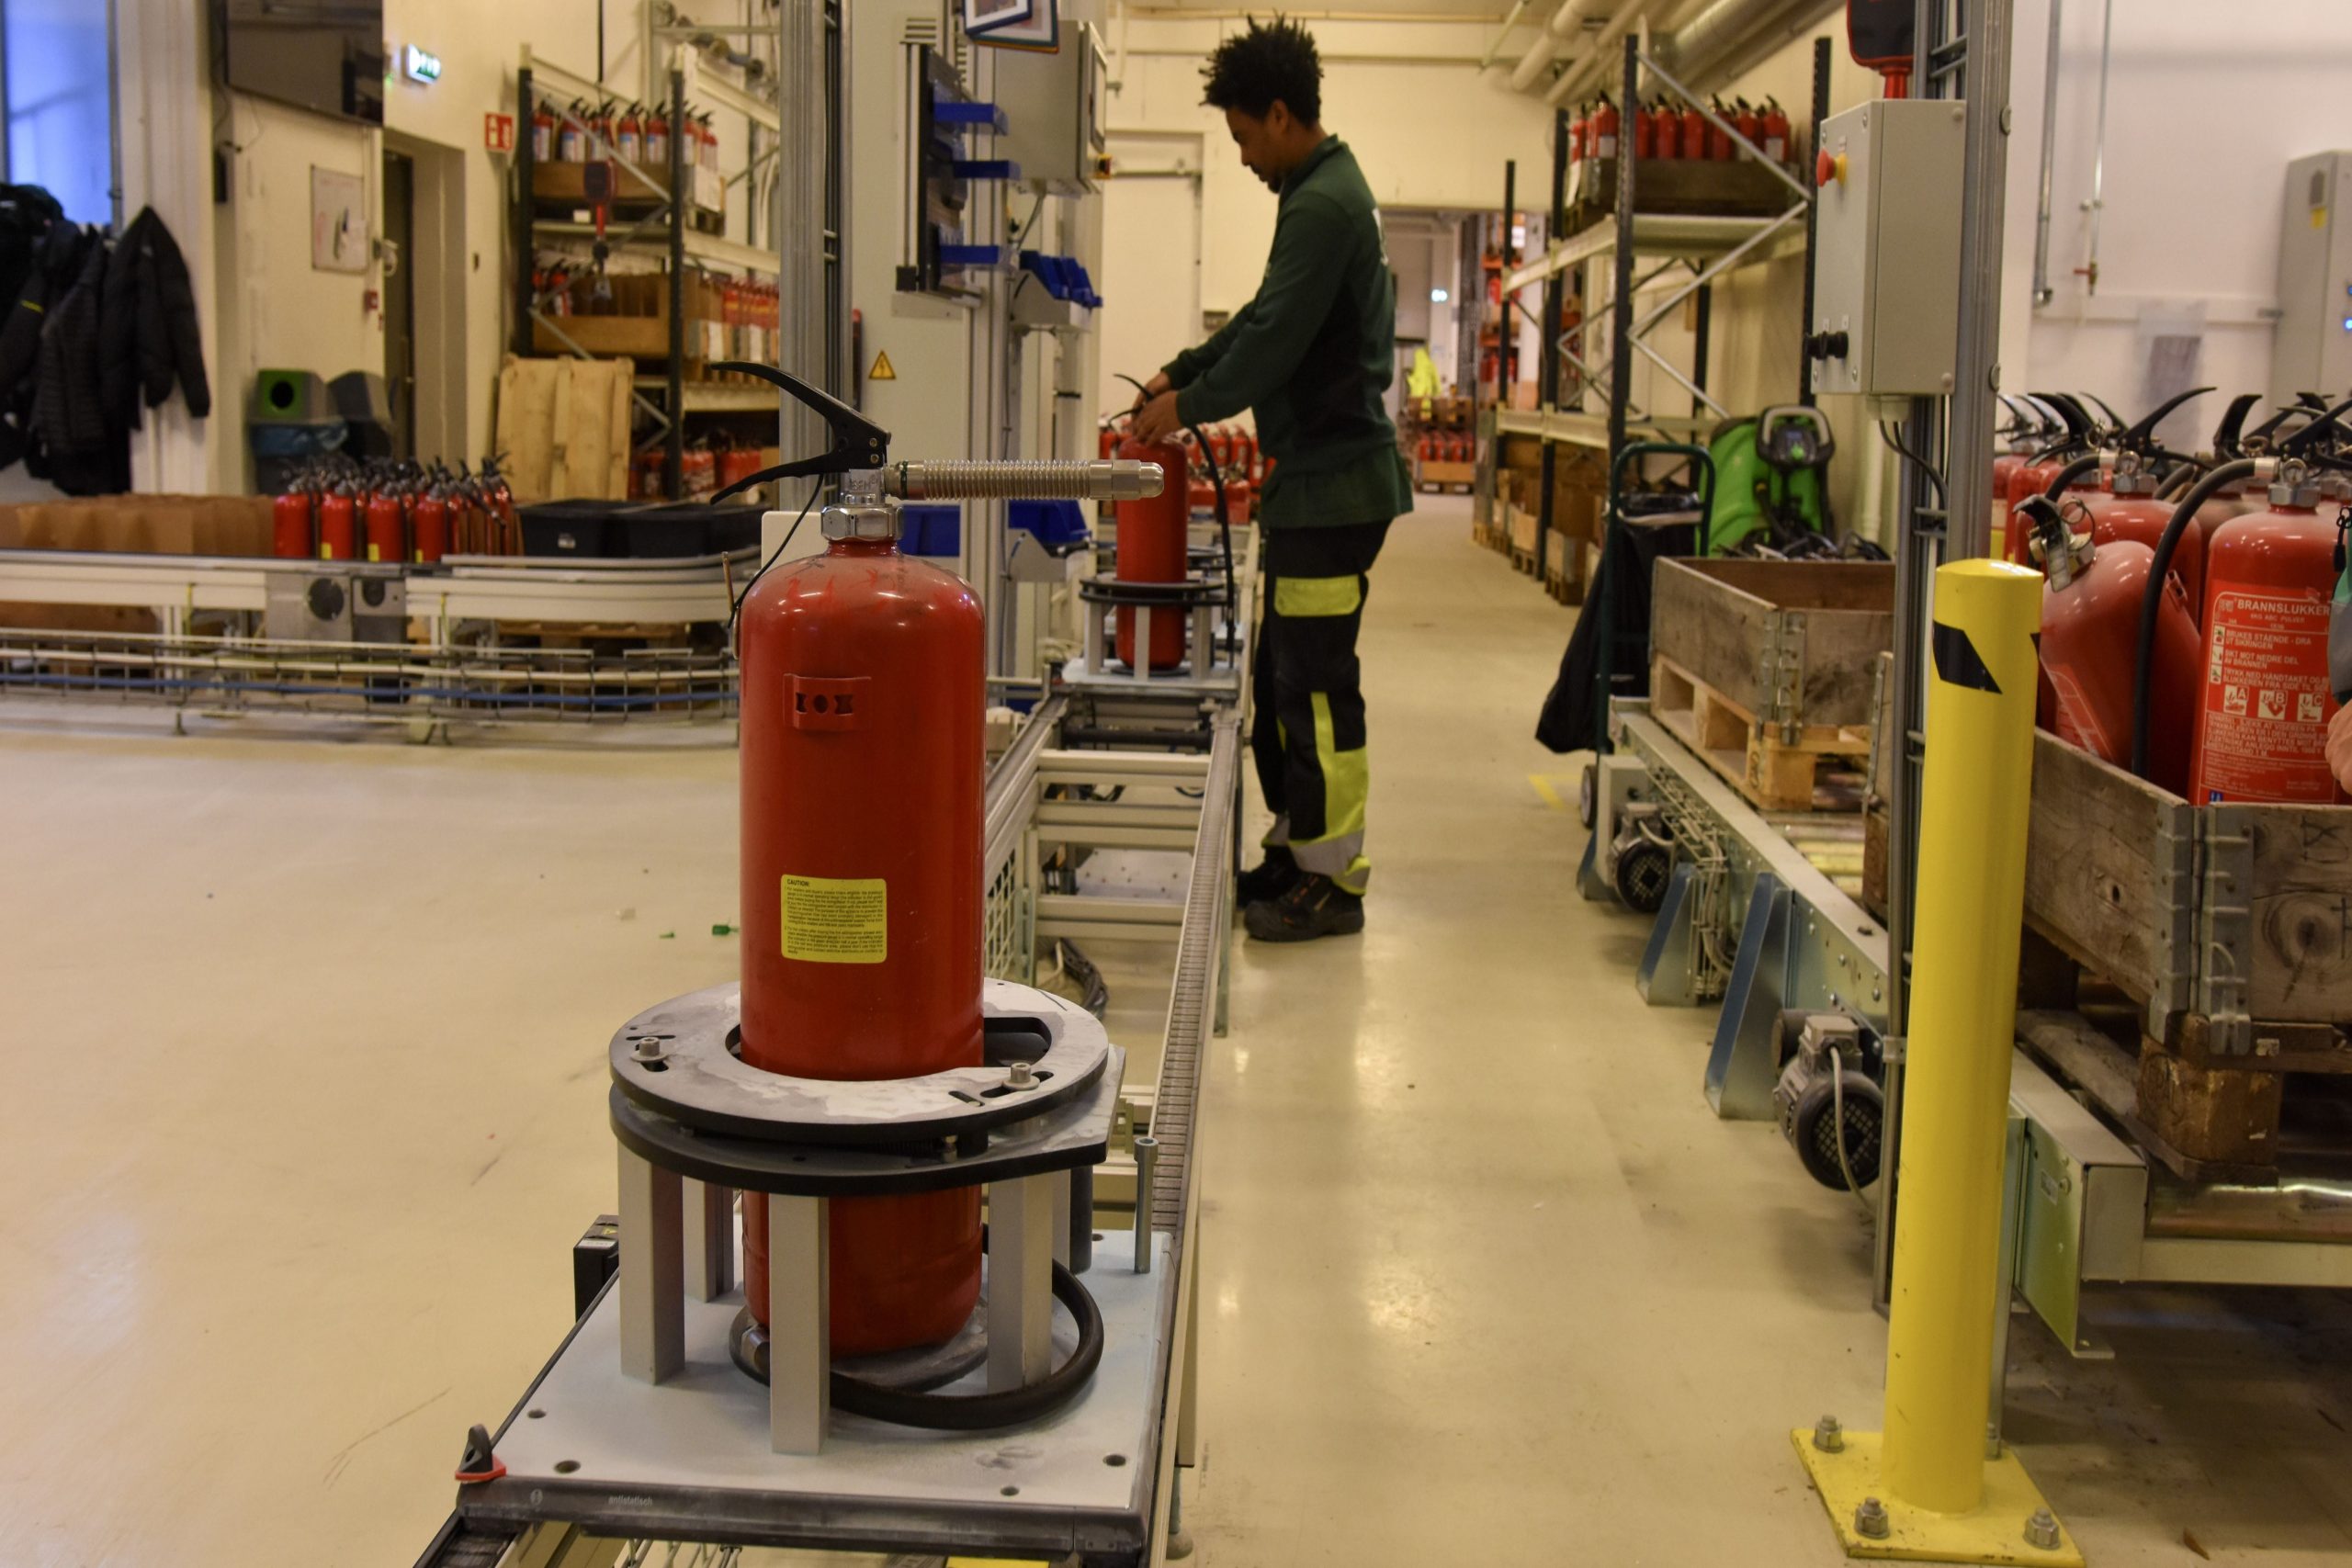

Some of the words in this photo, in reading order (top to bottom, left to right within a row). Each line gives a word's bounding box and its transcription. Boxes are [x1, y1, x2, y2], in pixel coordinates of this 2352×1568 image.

[2237, 599, 2330, 615] BRANNSLUKKER
[2295, 637, 2312, 645] DRA
[2237, 687, 2247, 699] A
[2276, 692, 2285, 704] B
[2313, 694, 2324, 706] C
